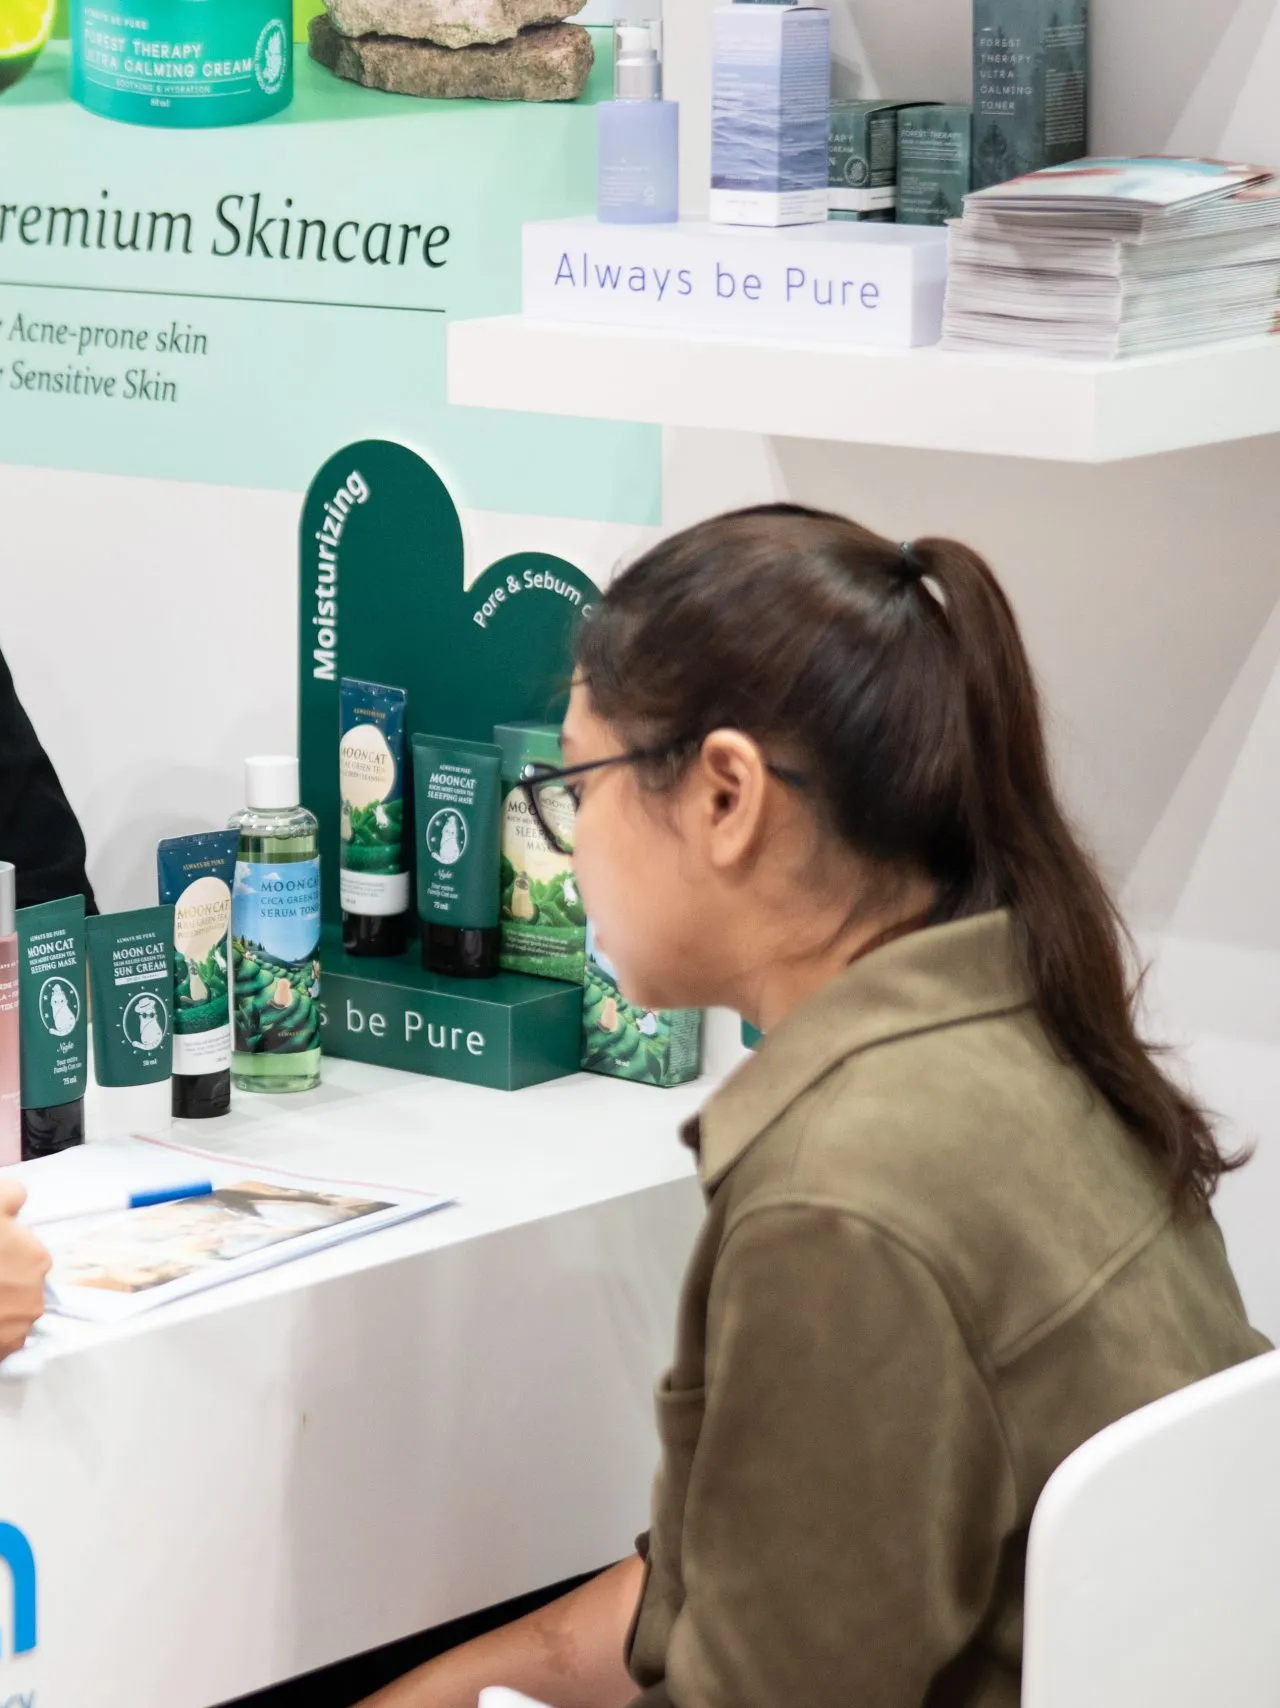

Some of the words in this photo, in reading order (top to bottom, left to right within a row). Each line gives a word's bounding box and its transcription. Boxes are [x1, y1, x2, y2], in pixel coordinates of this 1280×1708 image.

[132, 39, 202, 59] THERAPY
[980, 38, 1021, 47] FOREST
[124, 58, 196, 78] CALMING
[202, 58, 252, 78] CREAM
[981, 55, 1031, 64] THERAPY
[980, 70, 1014, 79] ULTRA
[980, 85, 1033, 95] CALMING
[981, 101, 1015, 111] TONER
[210, 192, 450, 269] Skincare
[554, 252, 693, 302] Always
[716, 262, 763, 301] be
[786, 267, 880, 308] Pure
[7, 312, 149, 356] Acne-prone
[155, 322, 209, 355] skin
[10, 360, 116, 397] Sensitive
[123, 368, 177, 402] Skin
[312, 470, 369, 681] Moisturizing
[473, 587, 506, 629] Pore
[506, 575, 521, 594] &
[523, 569, 581, 606] Sebum
[427, 790, 458, 802] SLEEPING
[260, 896, 284, 905] CICA
[287, 894, 312, 904] GREEN
[260, 907, 298, 918] SERUM
[112, 946, 144, 961] MOON
[145, 942, 165, 955] CAT
[57, 956, 77, 968] MASK
[114, 965, 133, 978] SUN
[136, 960, 167, 974] CREAM
[346, 999, 386, 1037] be
[405, 1010, 485, 1055] Pure
